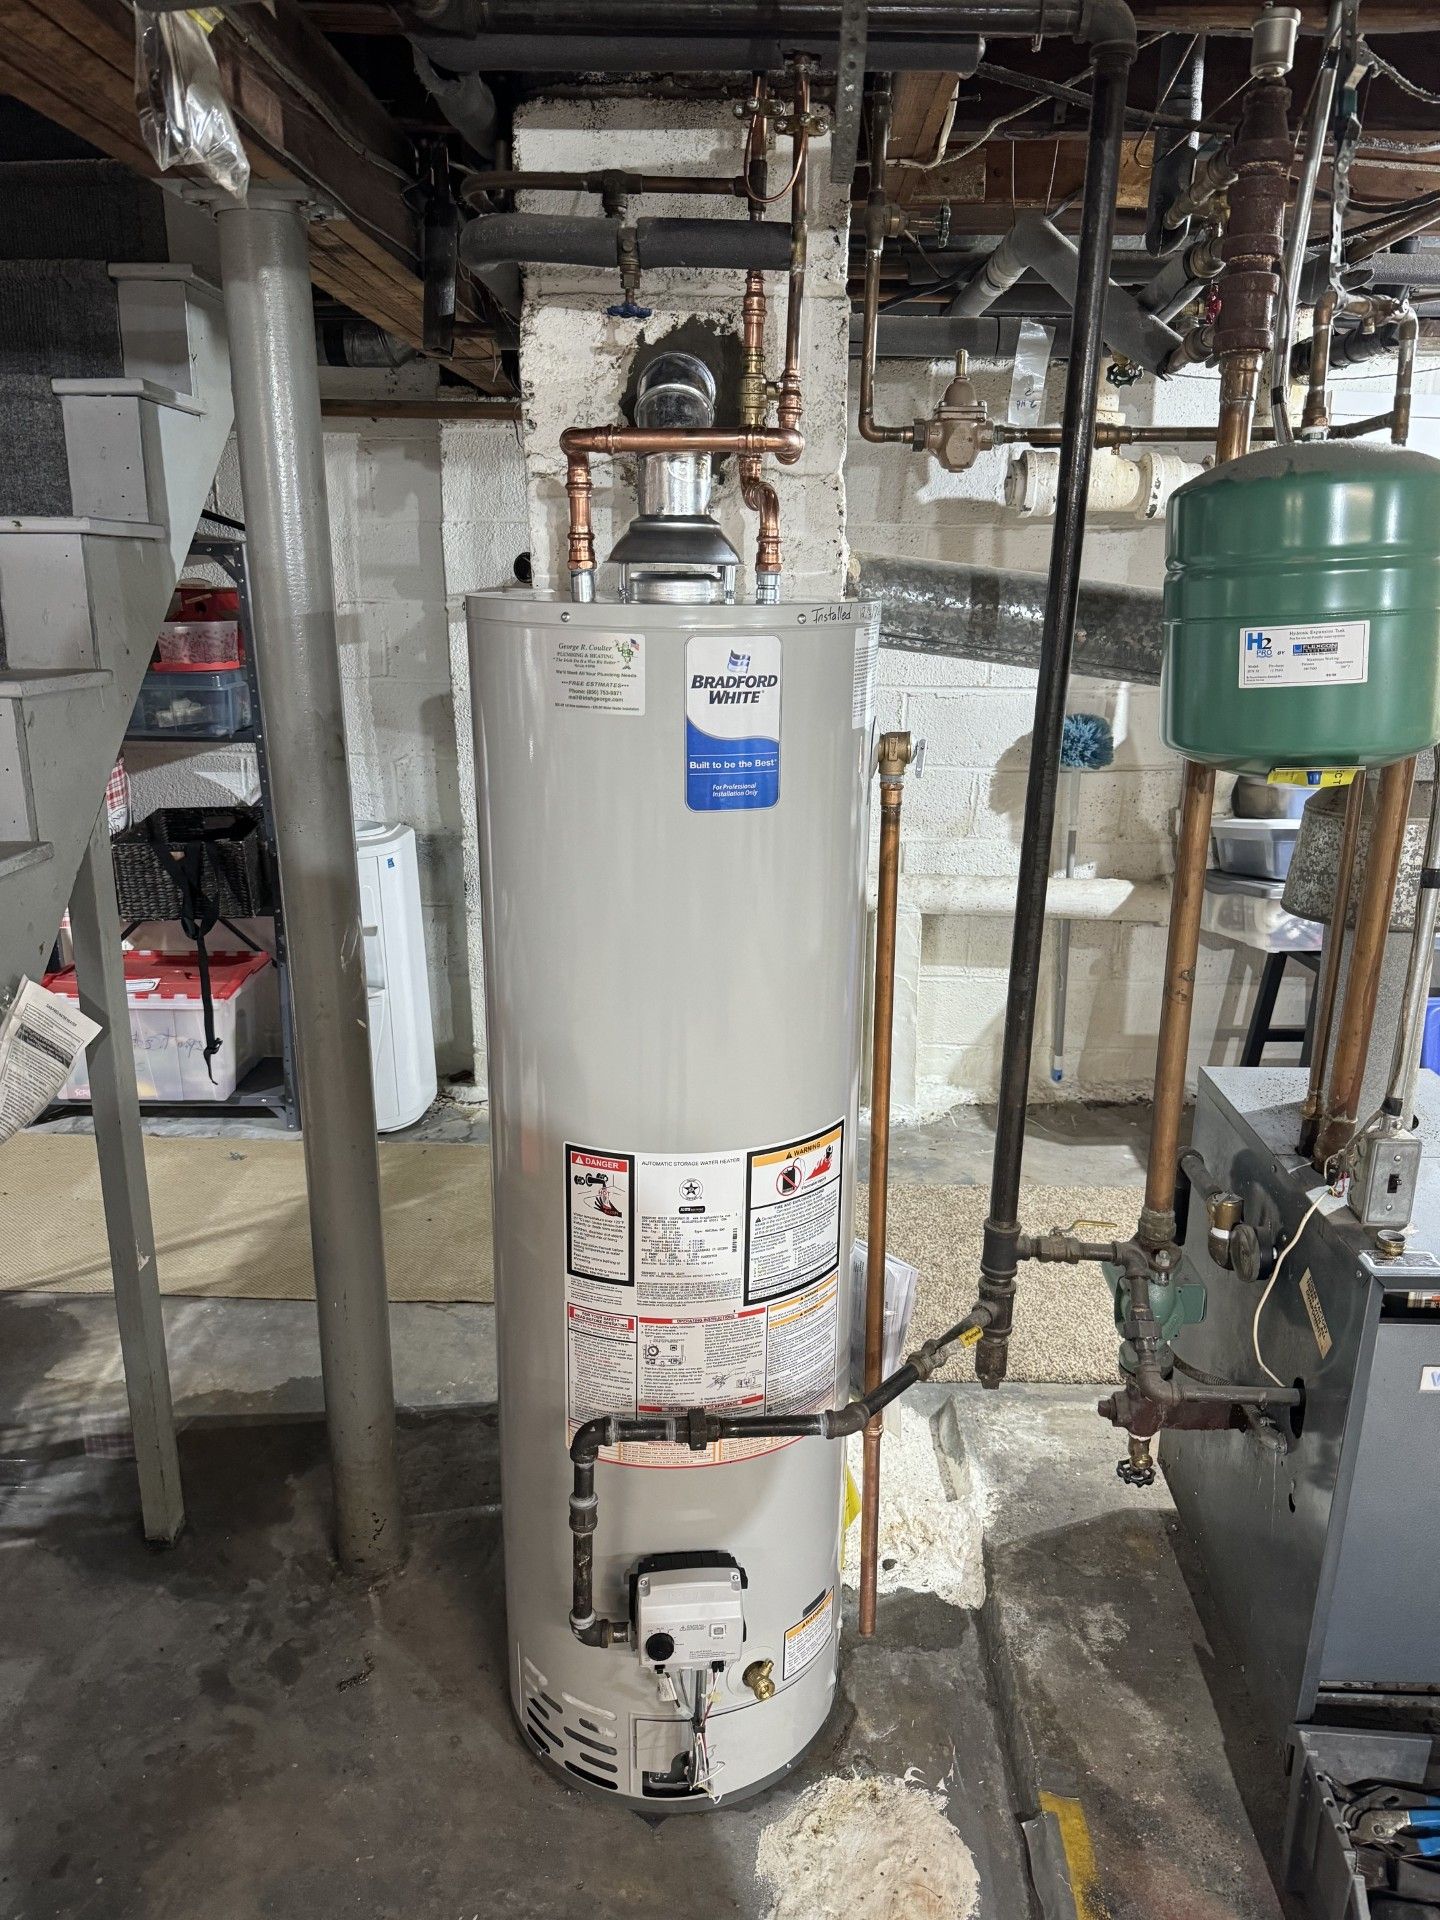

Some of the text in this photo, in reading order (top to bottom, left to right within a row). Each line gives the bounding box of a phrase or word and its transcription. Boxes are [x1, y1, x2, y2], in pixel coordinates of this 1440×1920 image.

[811, 603, 852, 624] Installed
[559, 643, 578, 651] George
[1247, 632, 1272, 650] H2
[691, 674, 778, 688] BRADFORD
[709, 690, 760, 704] WHITE
[755, 759, 775, 767] Best
[745, 789, 758, 797] Only
[794, 1142, 820, 1156] WARNING
[585, 1158, 619, 1169] DANGER
